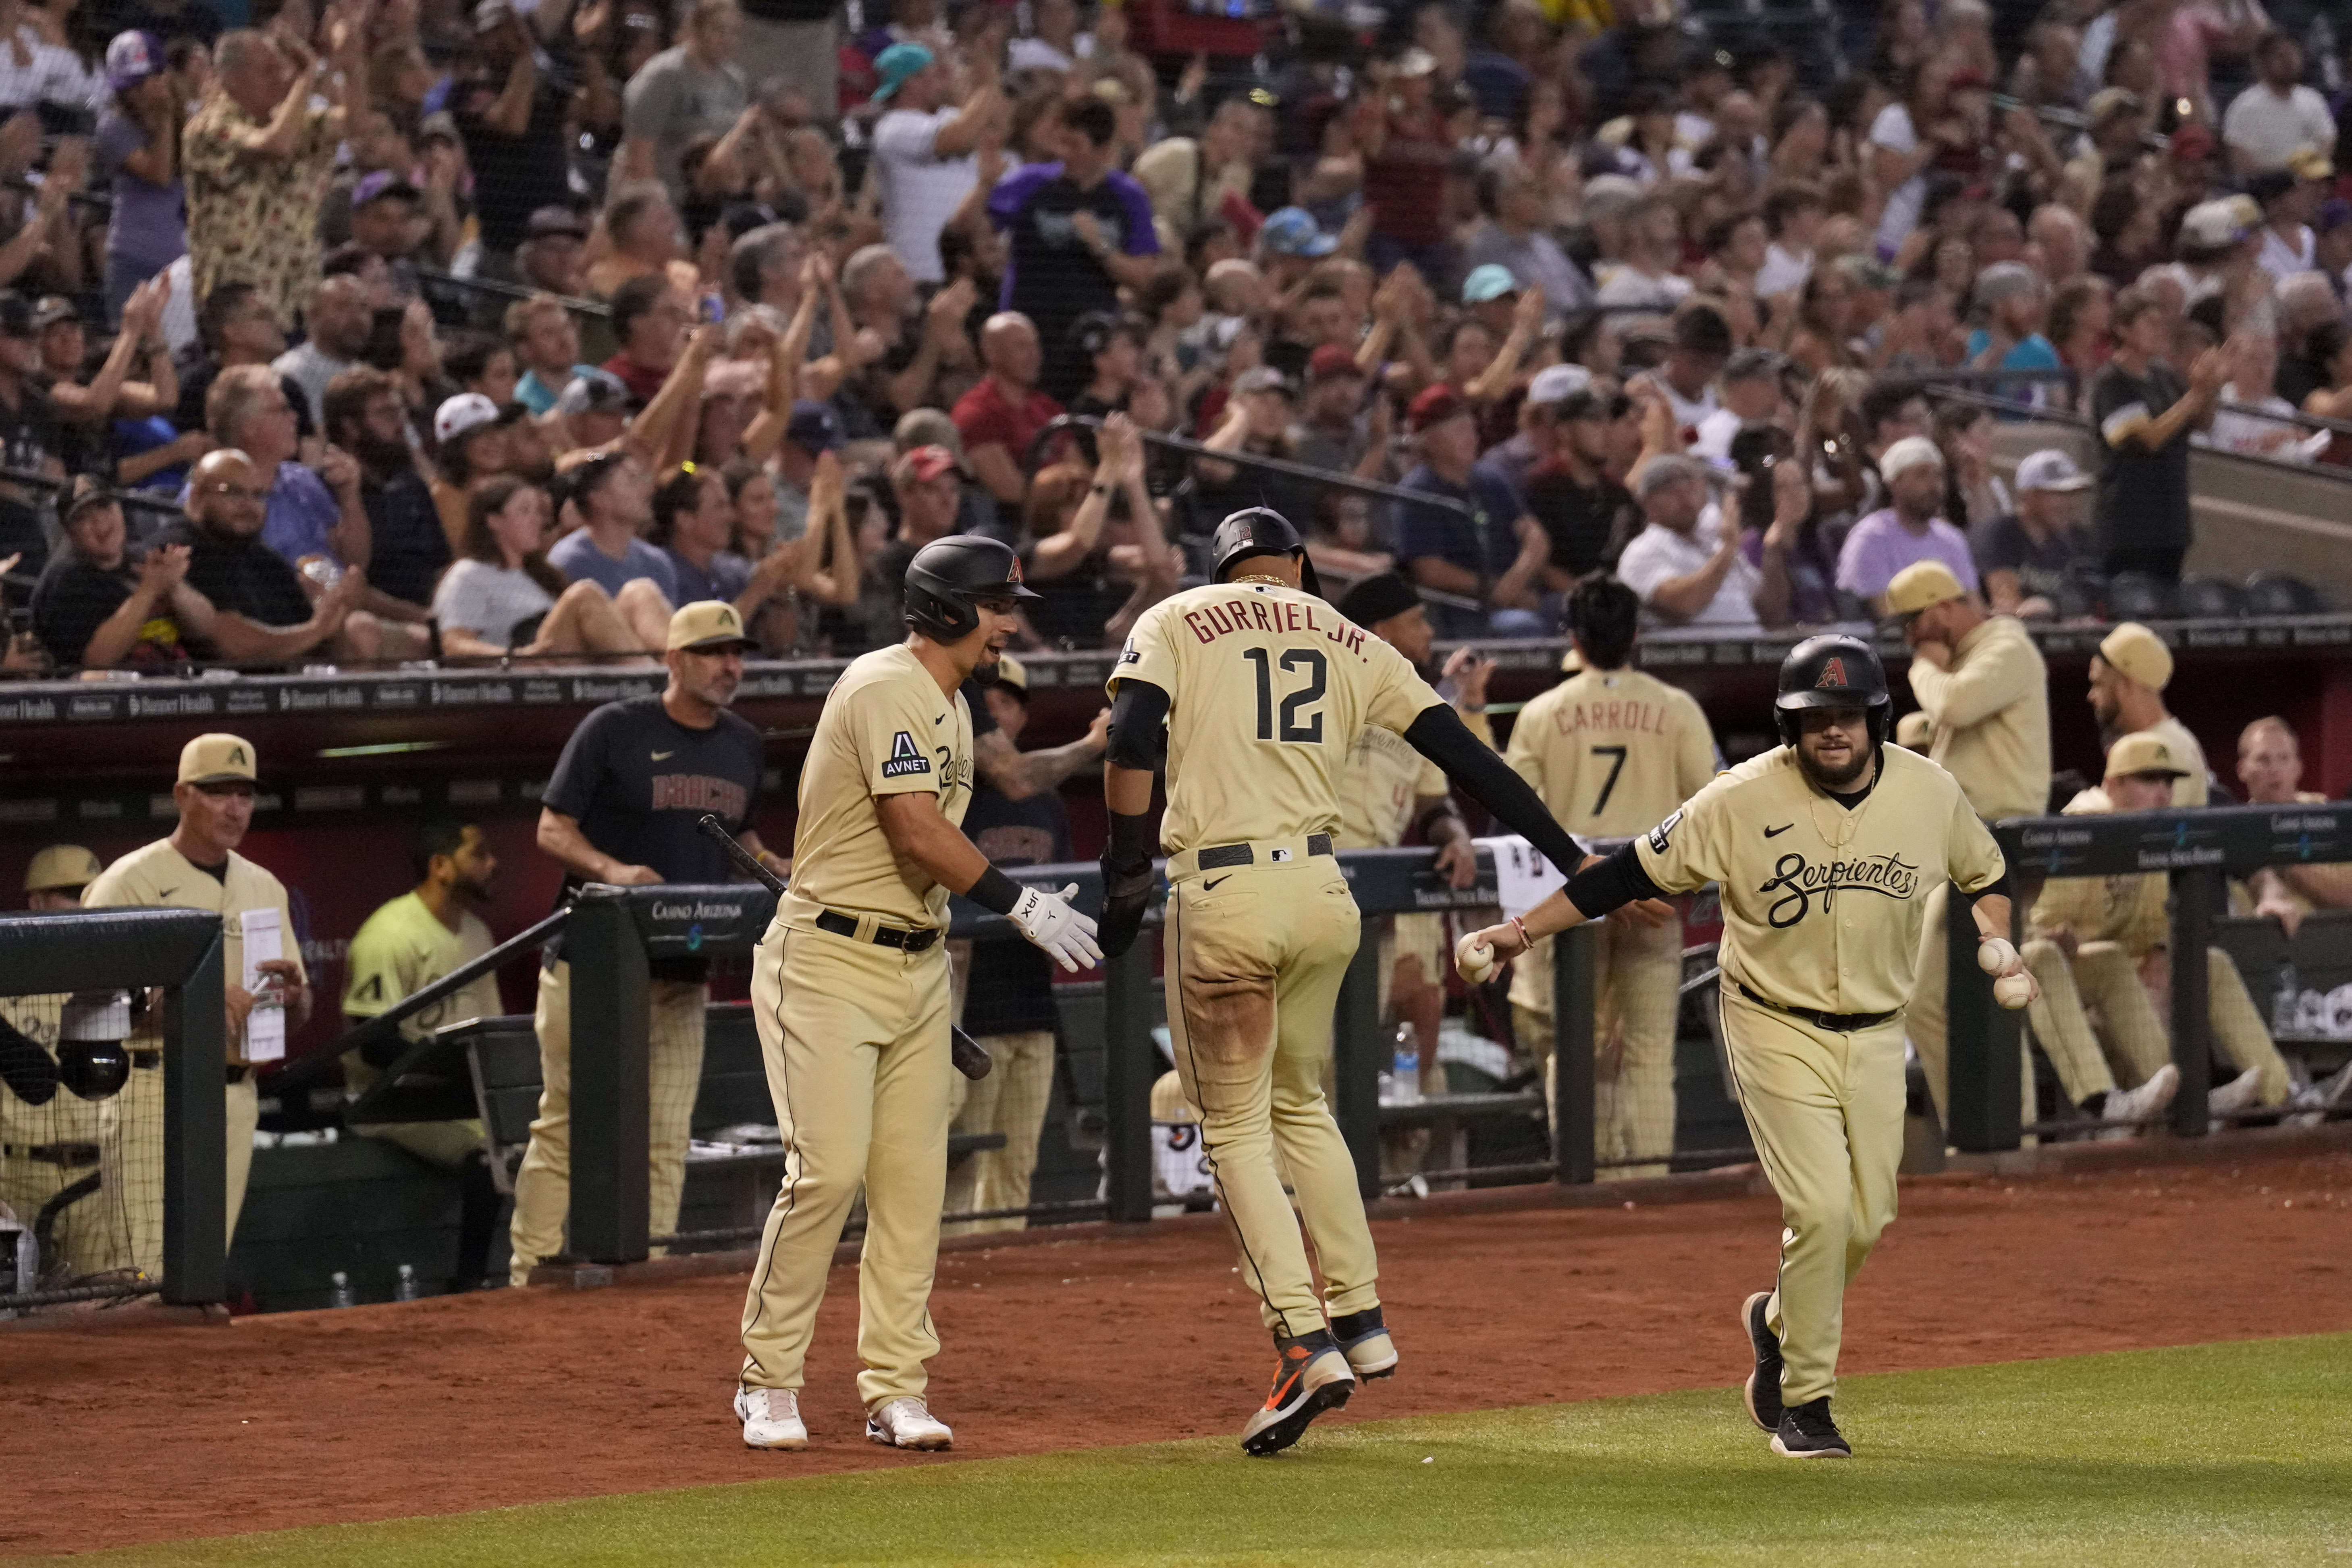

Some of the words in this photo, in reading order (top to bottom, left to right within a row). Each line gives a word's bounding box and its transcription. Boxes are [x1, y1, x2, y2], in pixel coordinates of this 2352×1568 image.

[1234, 526, 1252, 541] 12
[1184, 600, 1321, 644] GURRIEL
[1327, 622, 1368, 664] JR.
[1244, 647, 1327, 744] 12
[1554, 700, 1665, 736] CARROLL
[887, 759, 927, 775] AVNET
[1592, 746, 1626, 815] 7
[1021, 892, 1039, 919] JAX
[1755, 851, 1920, 928] Serpientes
